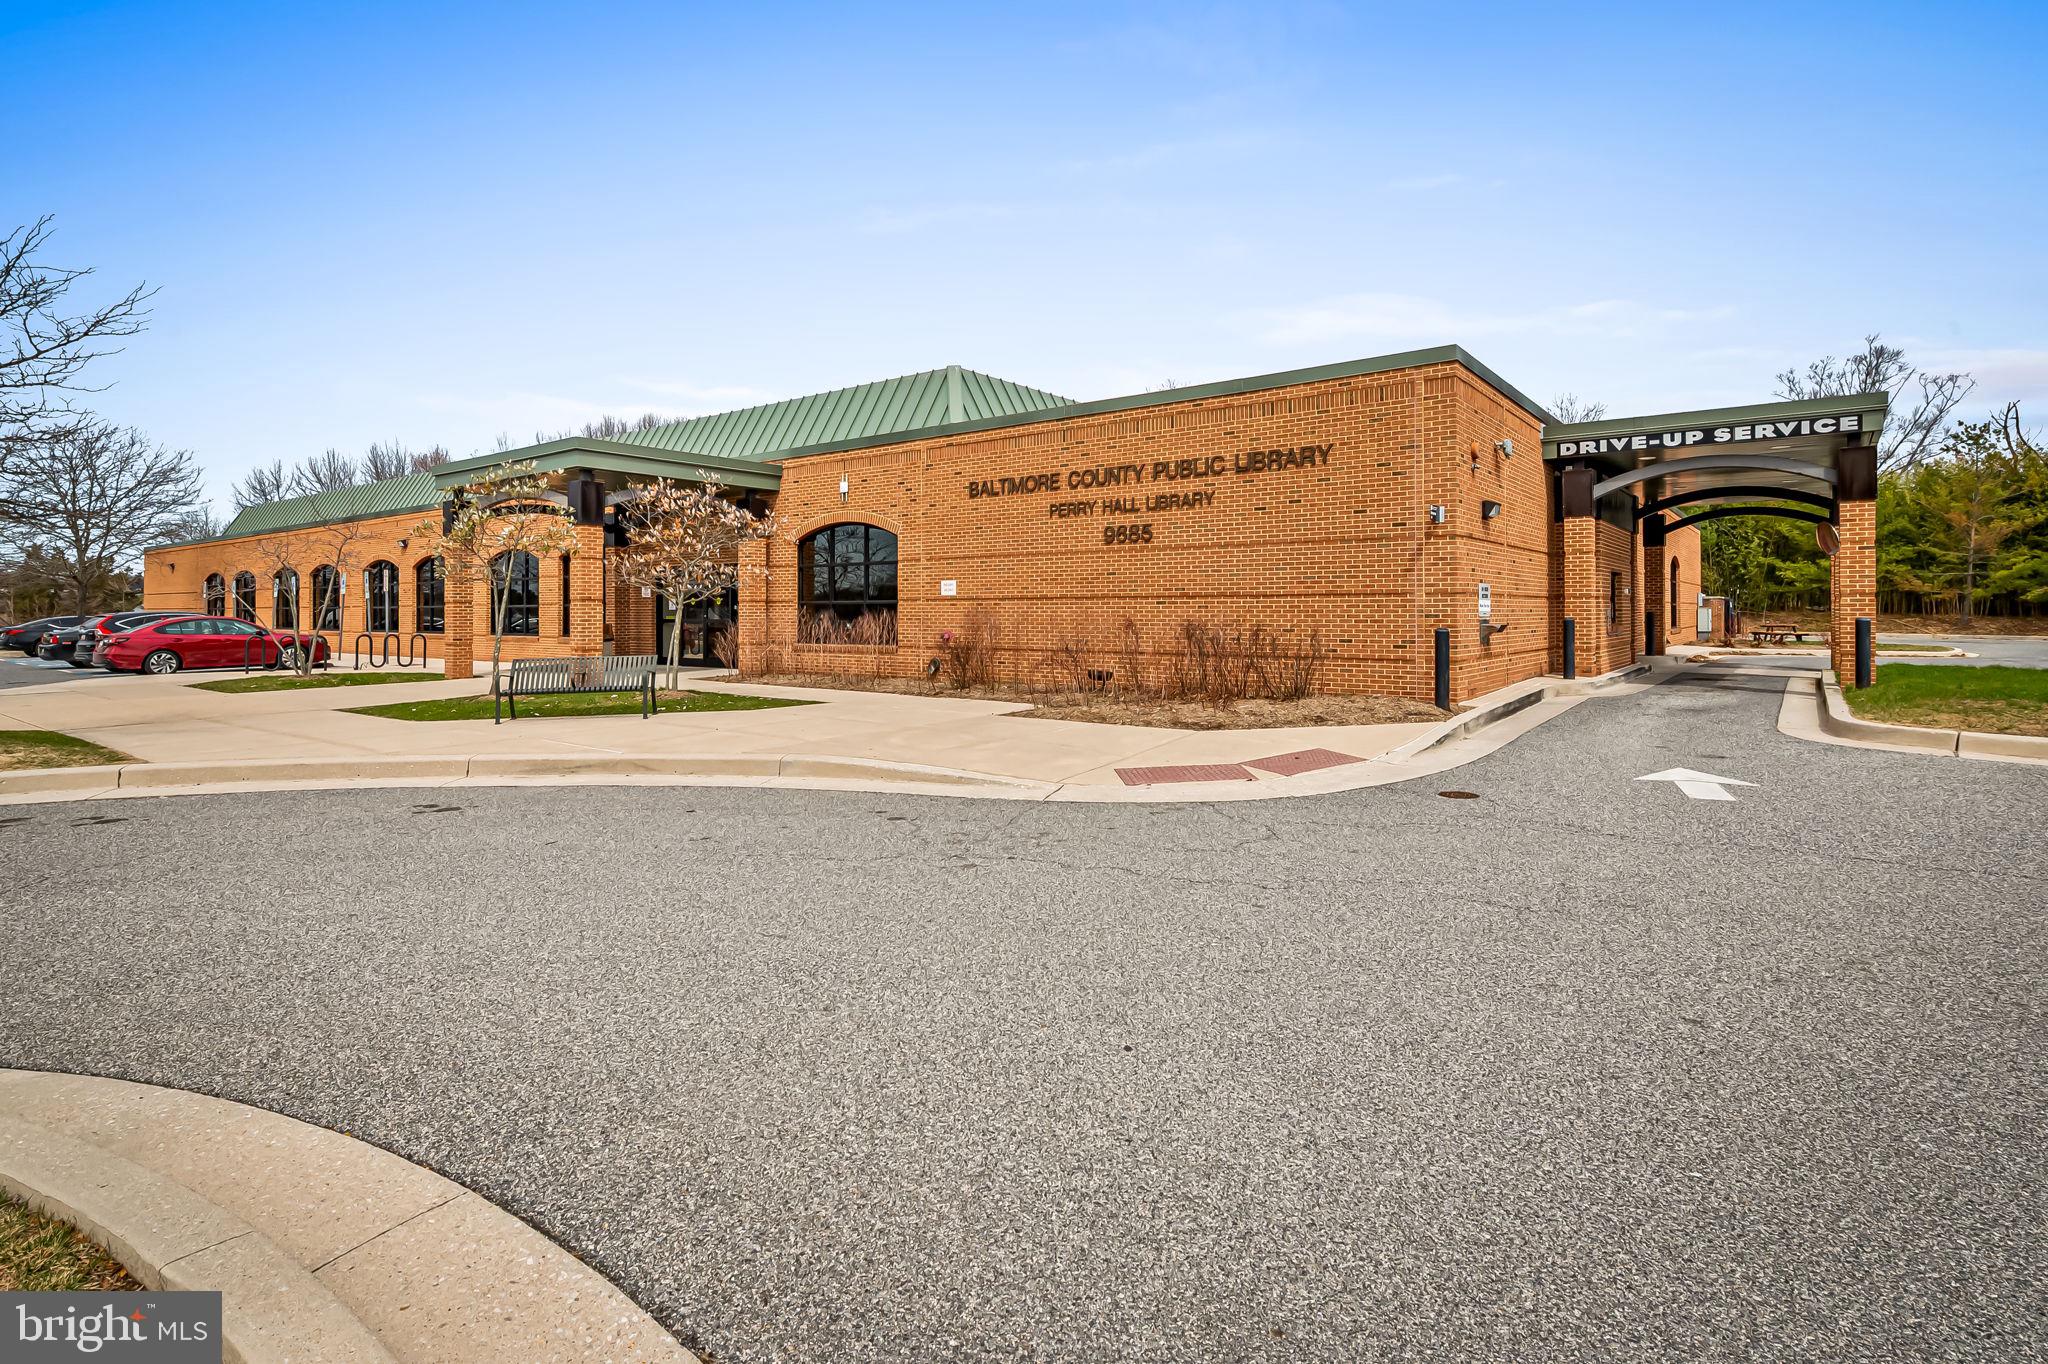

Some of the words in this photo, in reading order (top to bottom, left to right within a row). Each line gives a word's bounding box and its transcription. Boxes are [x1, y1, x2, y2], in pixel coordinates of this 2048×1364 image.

[1560, 431, 1704, 456] DRIVE-UP
[1713, 415, 1859, 442] SERVICE
[968, 473, 1061, 498] BALTIMORE
[1067, 463, 1146, 490] COUNTY
[1152, 455, 1226, 480] PUBLIC
[1233, 443, 1334, 473] LIBRARY
[1050, 499, 1097, 518] PERRY
[1102, 497, 1140, 515] HALL
[1145, 490, 1216, 512] LIBRARY
